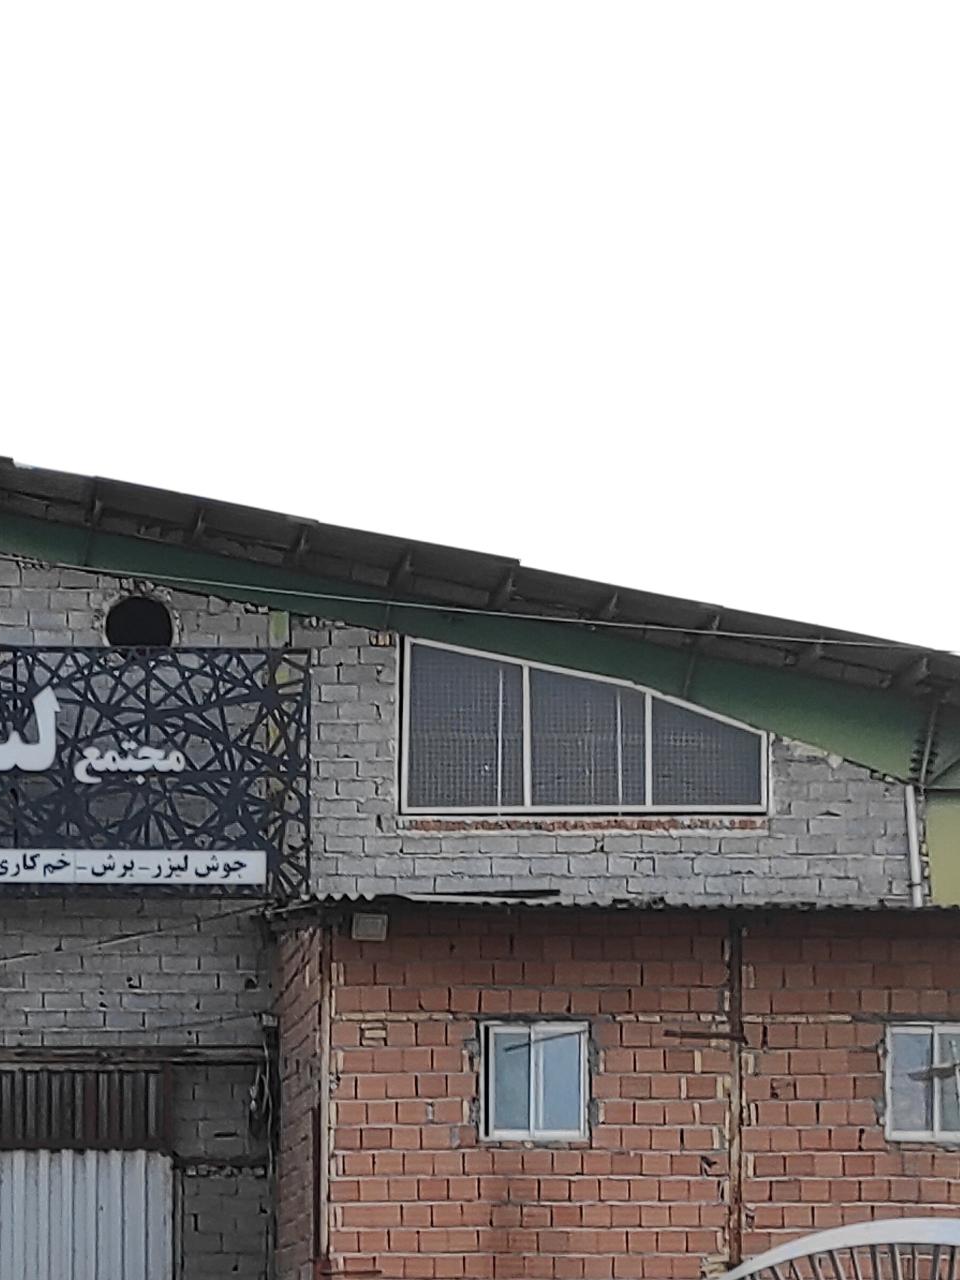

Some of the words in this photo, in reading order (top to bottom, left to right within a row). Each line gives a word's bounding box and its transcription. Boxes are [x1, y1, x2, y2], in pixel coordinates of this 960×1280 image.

[73, 741, 185, 785] مجتمع
[91, 854, 135, 878] برش
[151, 854, 189, 879] لیزر
[194, 855, 247, 879] جوش
